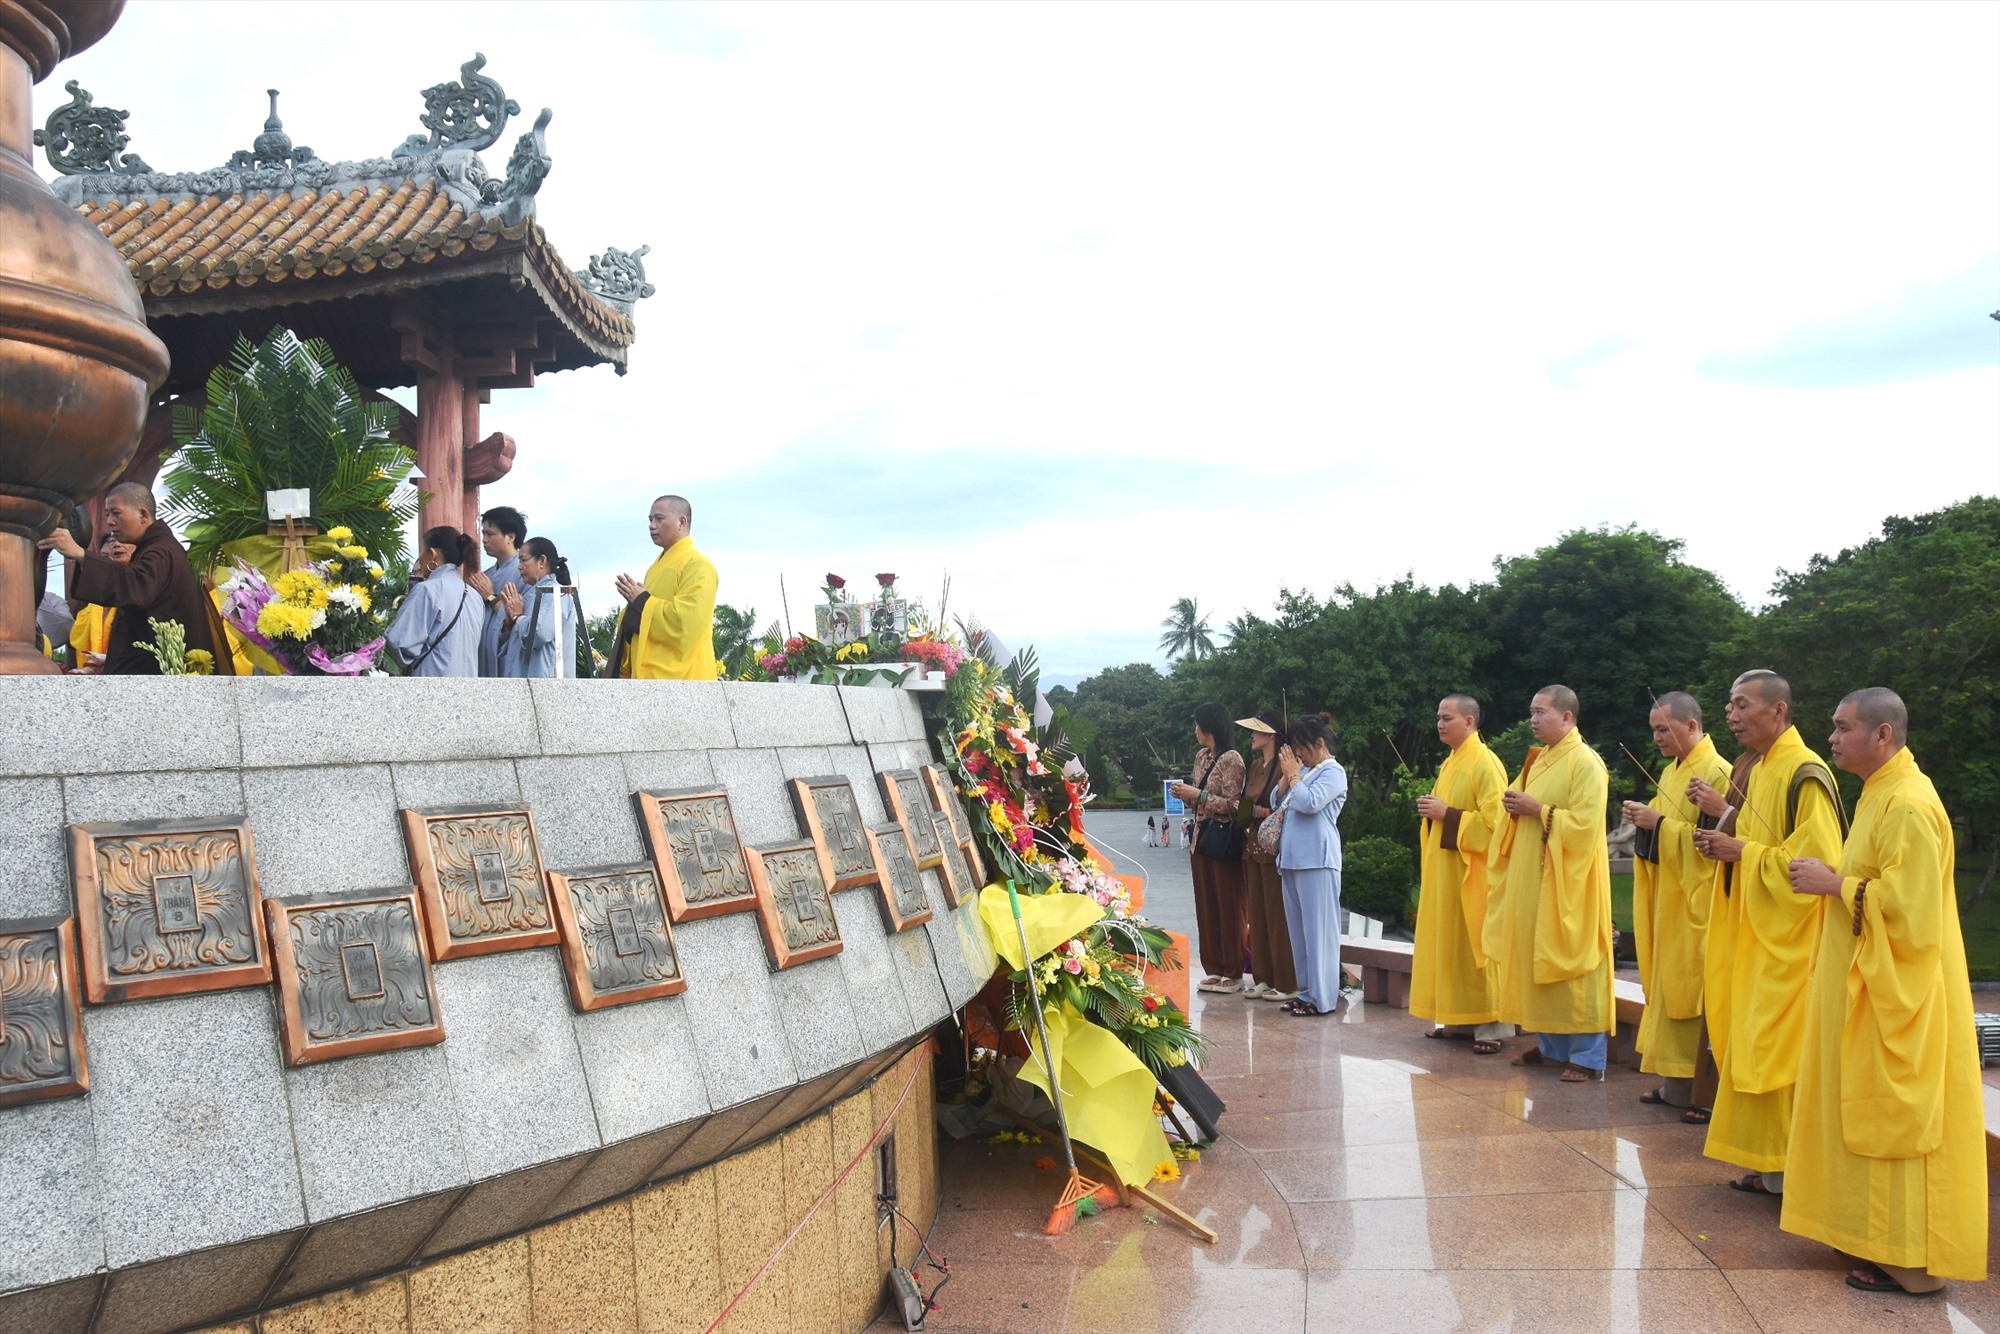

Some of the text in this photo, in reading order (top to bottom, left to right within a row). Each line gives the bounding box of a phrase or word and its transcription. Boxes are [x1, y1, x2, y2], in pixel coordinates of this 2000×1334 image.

[175, 911, 183, 921] 8
[353, 951, 366, 960] 20
[361, 979, 369, 988] 8
